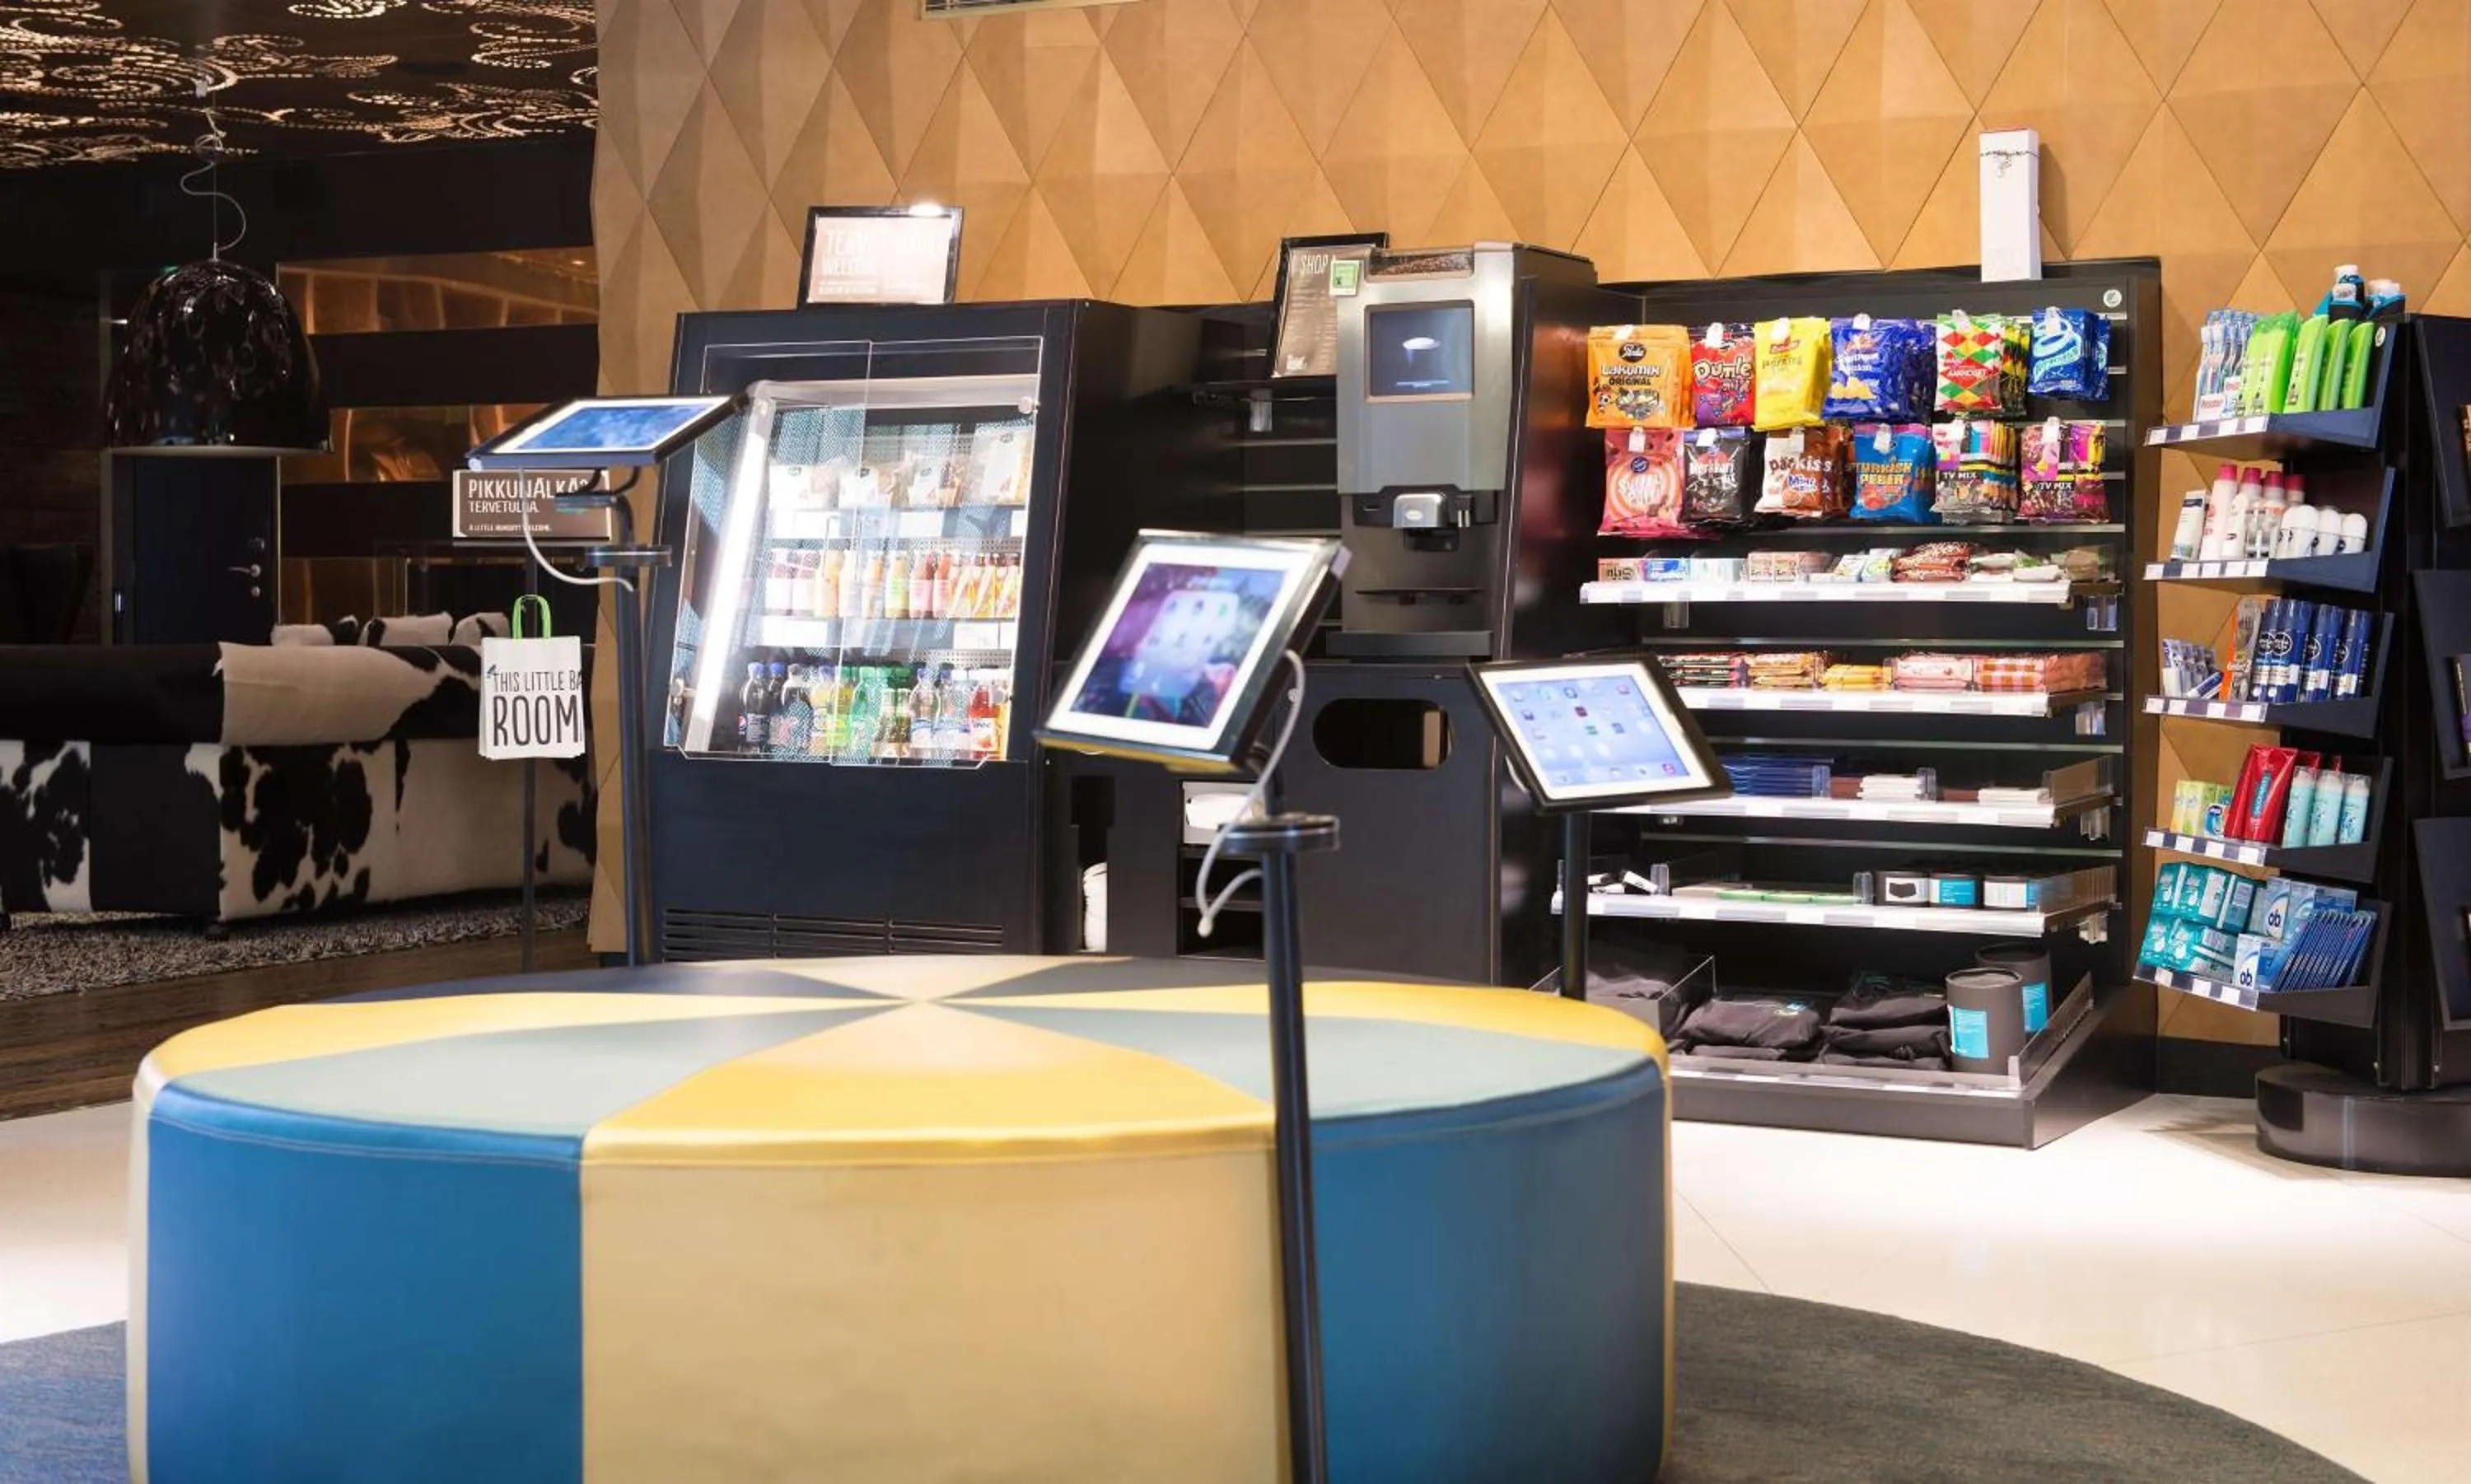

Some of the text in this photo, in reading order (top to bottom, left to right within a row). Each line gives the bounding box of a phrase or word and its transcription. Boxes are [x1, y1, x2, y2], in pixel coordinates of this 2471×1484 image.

[1693, 355, 1752, 378] Dumle
[2039, 482, 2072, 490] TV MIX
[493, 671, 520, 692] THIS
[525, 671, 565, 691] LITTLE
